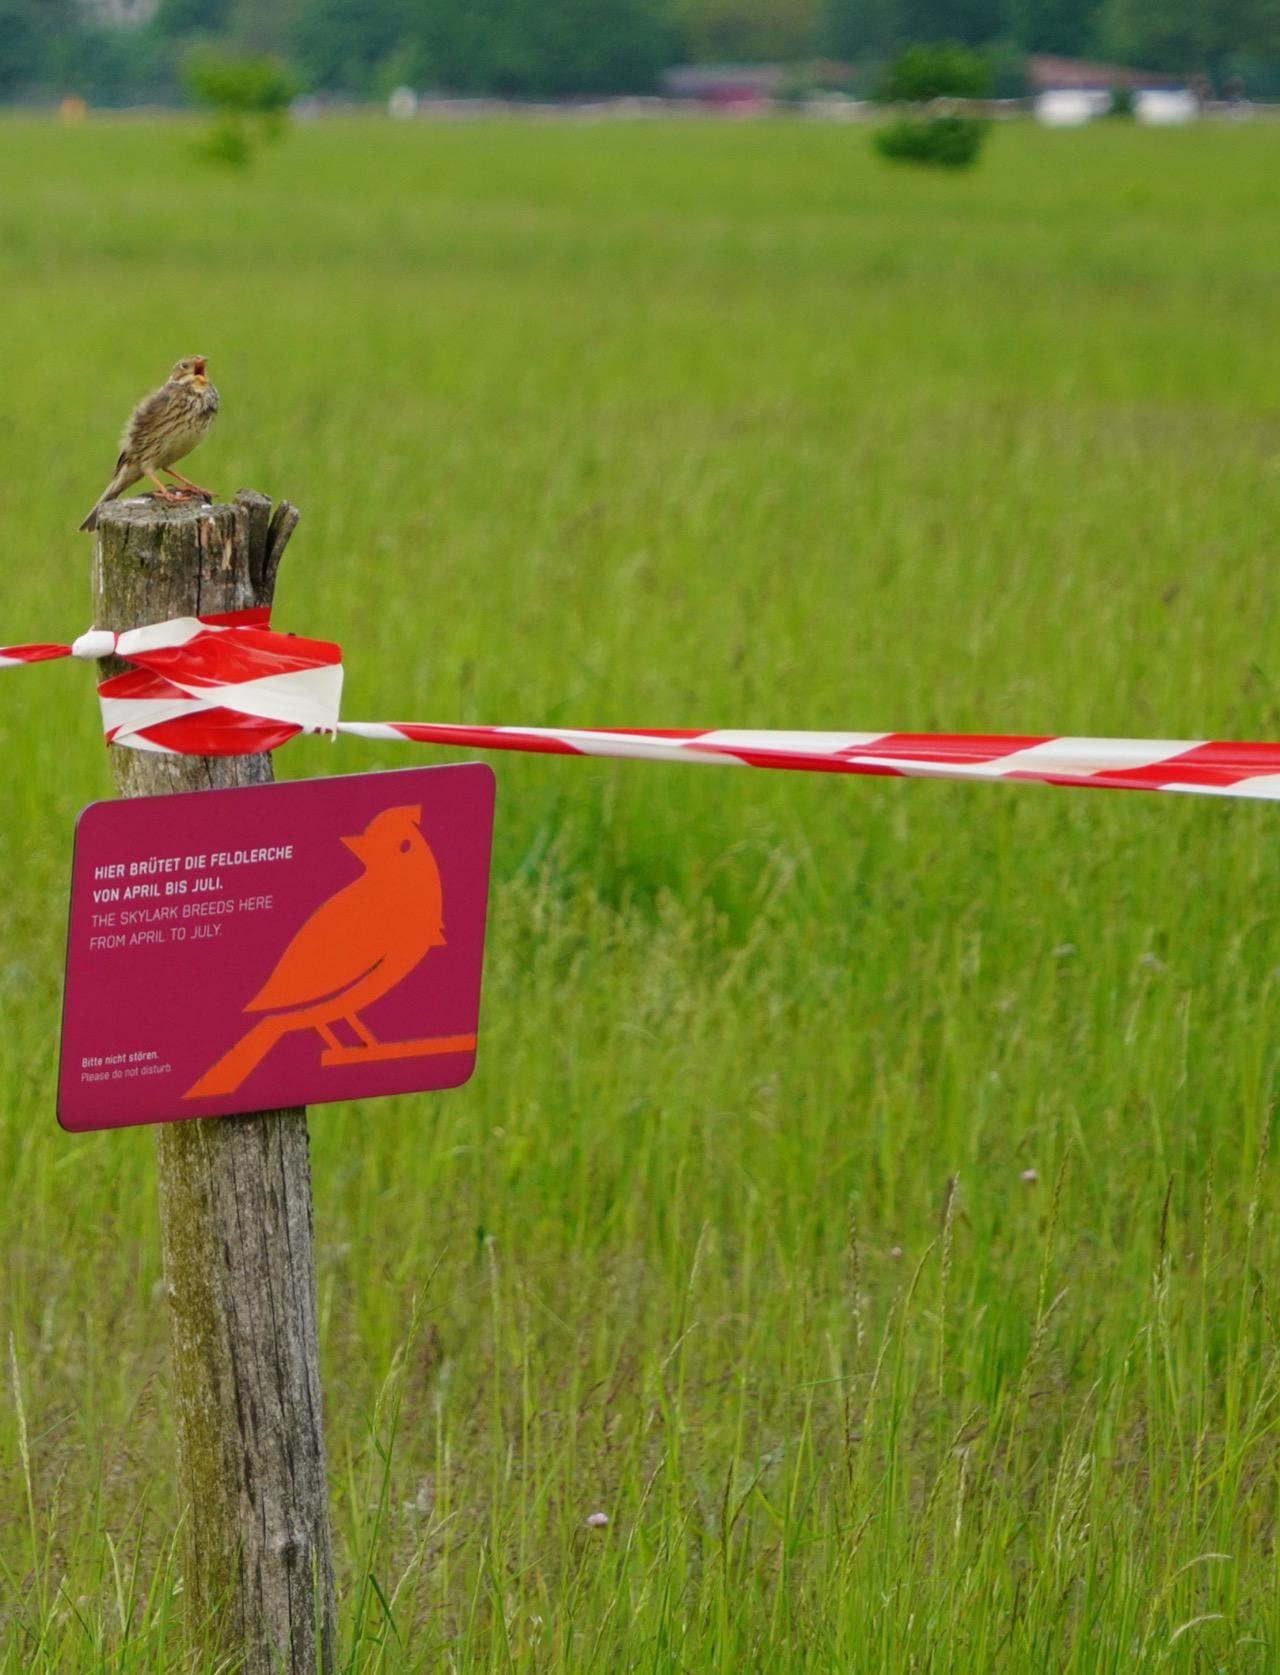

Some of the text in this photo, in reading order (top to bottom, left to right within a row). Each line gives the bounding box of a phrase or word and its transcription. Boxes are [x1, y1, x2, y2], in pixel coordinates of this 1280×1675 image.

[94, 845, 294, 880] HIER BRÜTET DIE FELDLERCHE
[93, 876, 223, 903] VON APRIL BIS JULI.
[92, 895, 273, 928] THE SKYLARK BREEDS HERE
[89, 923, 222, 950] FROM APRIL TO JULY.
[81, 1050, 160, 1068] Bitte nicht stören.
[81, 1063, 173, 1083] Please do not disturb.
